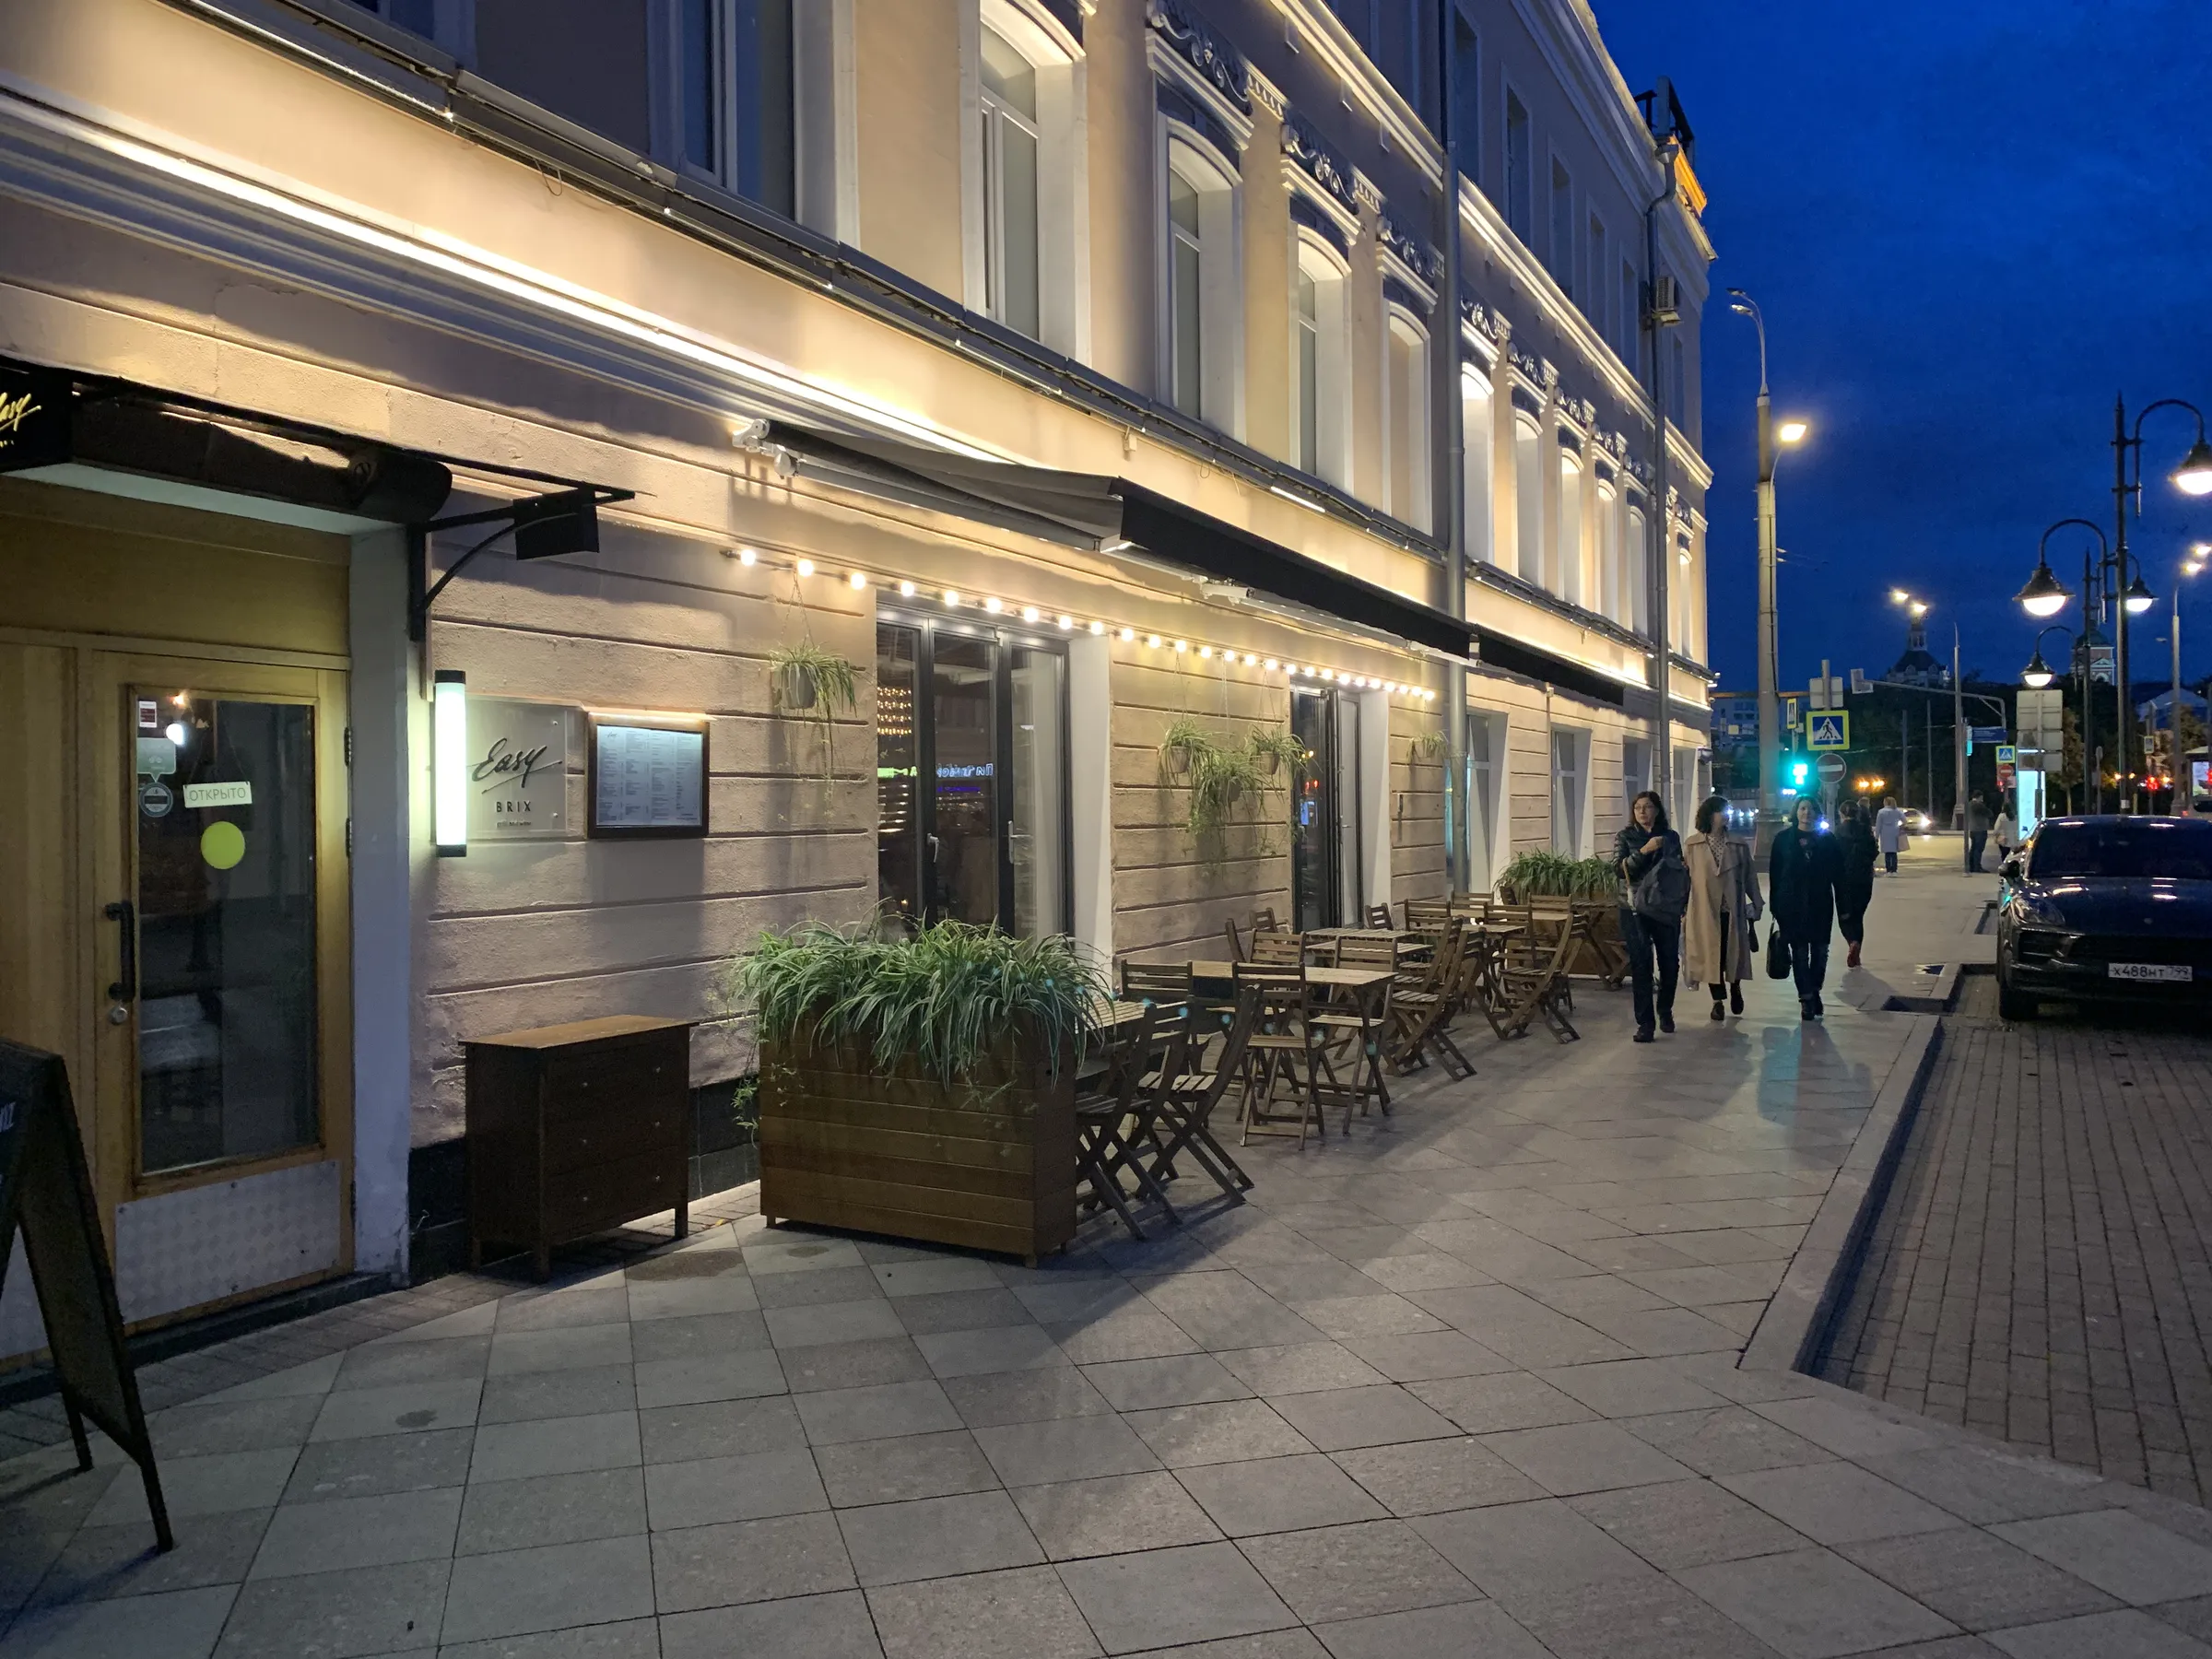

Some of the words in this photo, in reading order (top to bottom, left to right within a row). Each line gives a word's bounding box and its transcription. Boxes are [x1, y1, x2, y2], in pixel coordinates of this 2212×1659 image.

[0, 392, 34, 431] asy
[468, 737, 551, 790] Easy
[189, 787, 246, 802] ОТКРЫТО
[496, 801, 532, 813] BRIX
